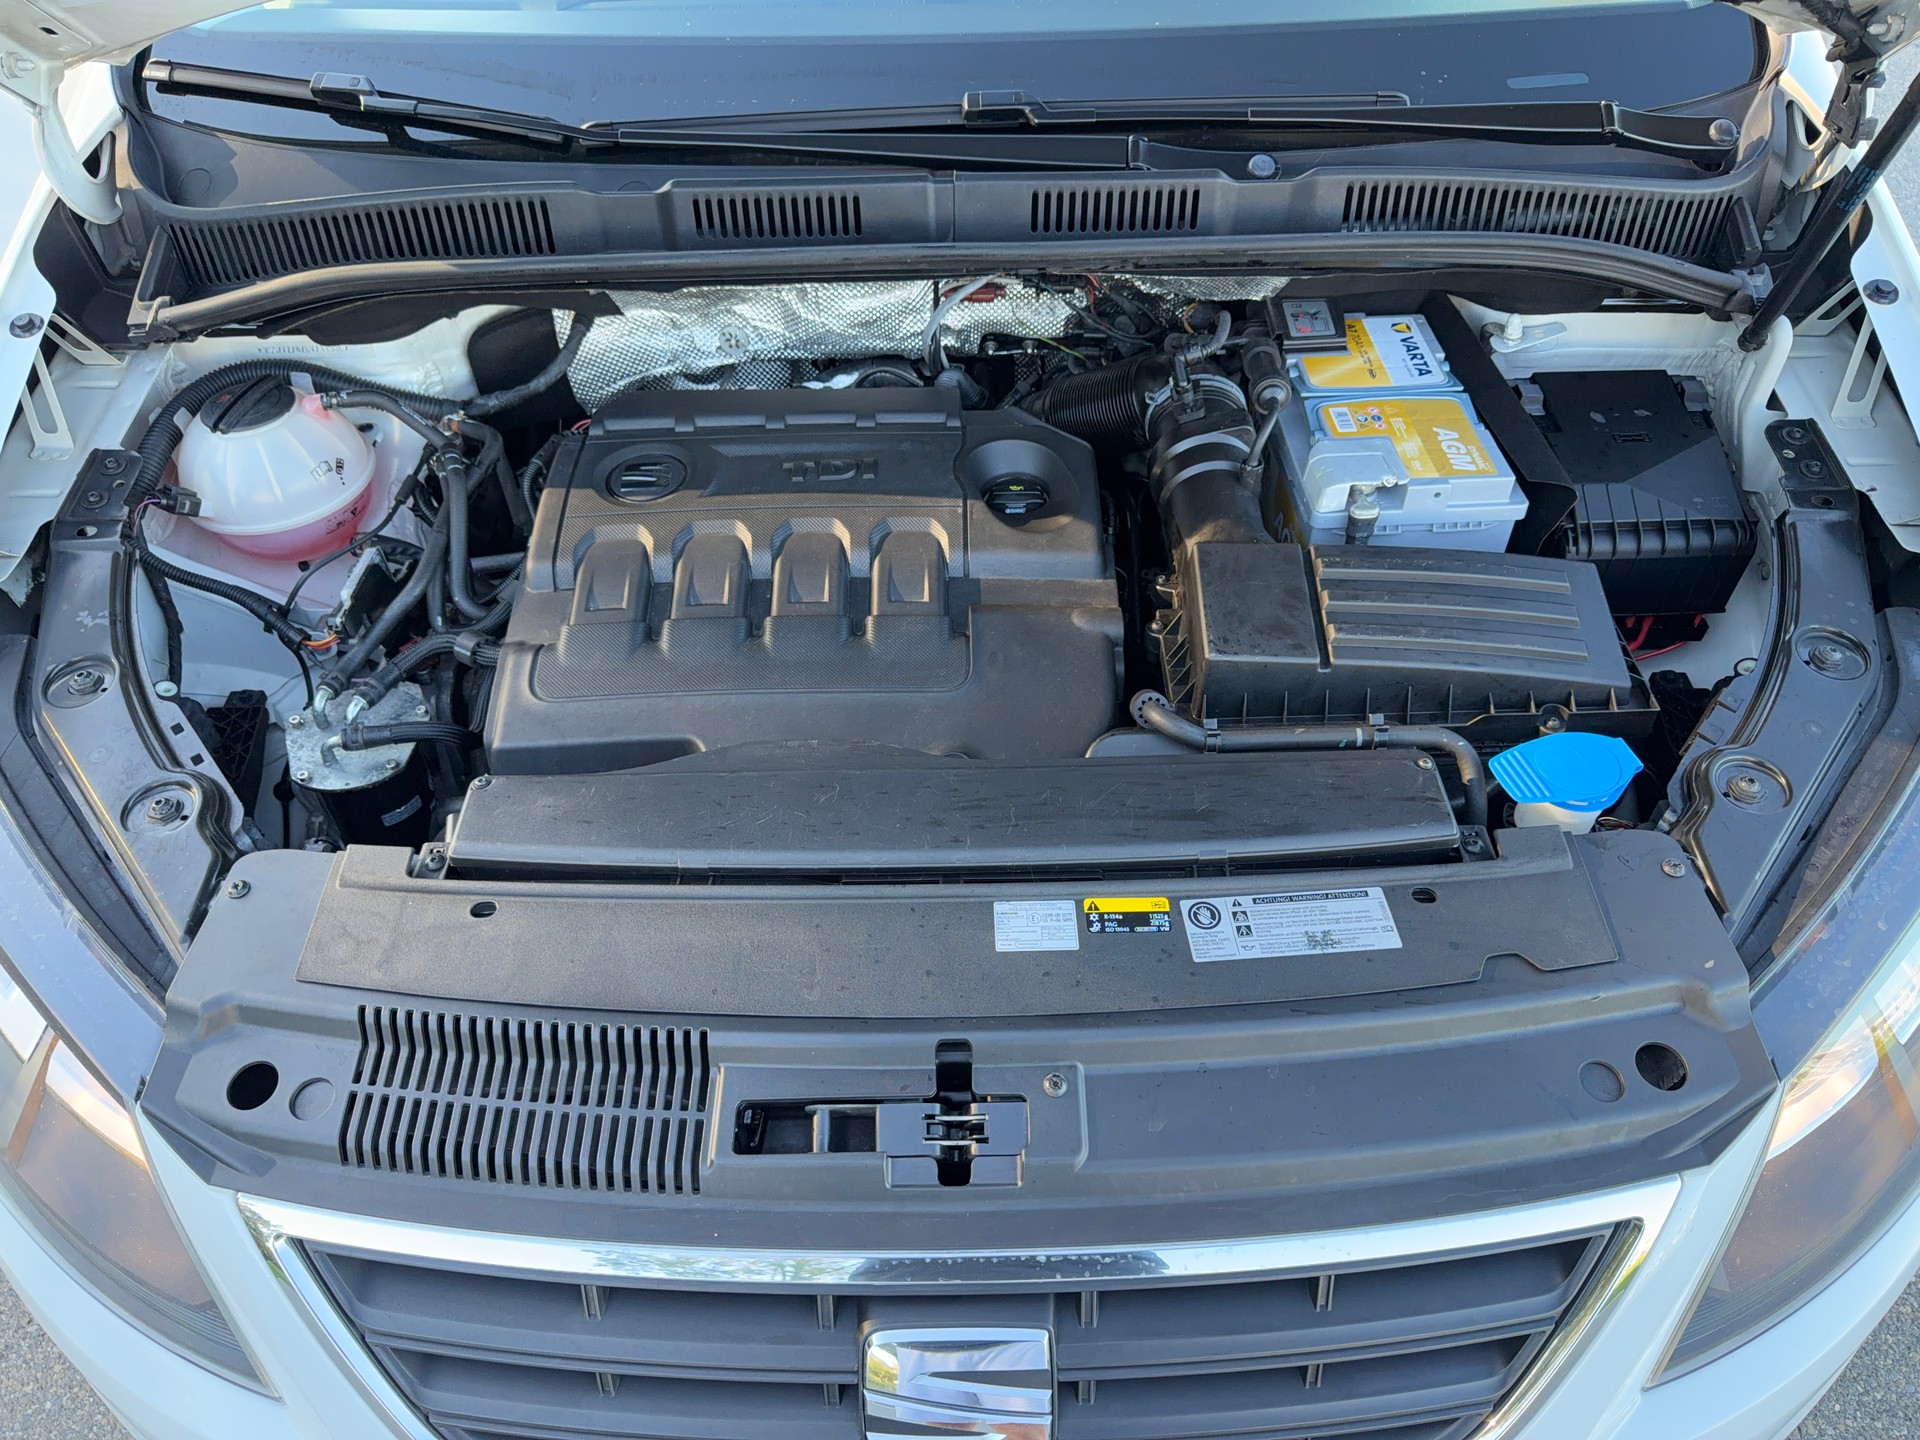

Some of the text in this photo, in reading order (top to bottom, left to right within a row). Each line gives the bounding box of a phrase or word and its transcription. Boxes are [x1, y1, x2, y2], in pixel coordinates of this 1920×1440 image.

[1400, 336, 1433, 376] VARTA
[1432, 427, 1477, 471] AGM
[782, 458, 878, 482] TDI
[1292, 893, 1326, 902] WARNING!
[1328, 891, 1366, 899] ATTENTION!
